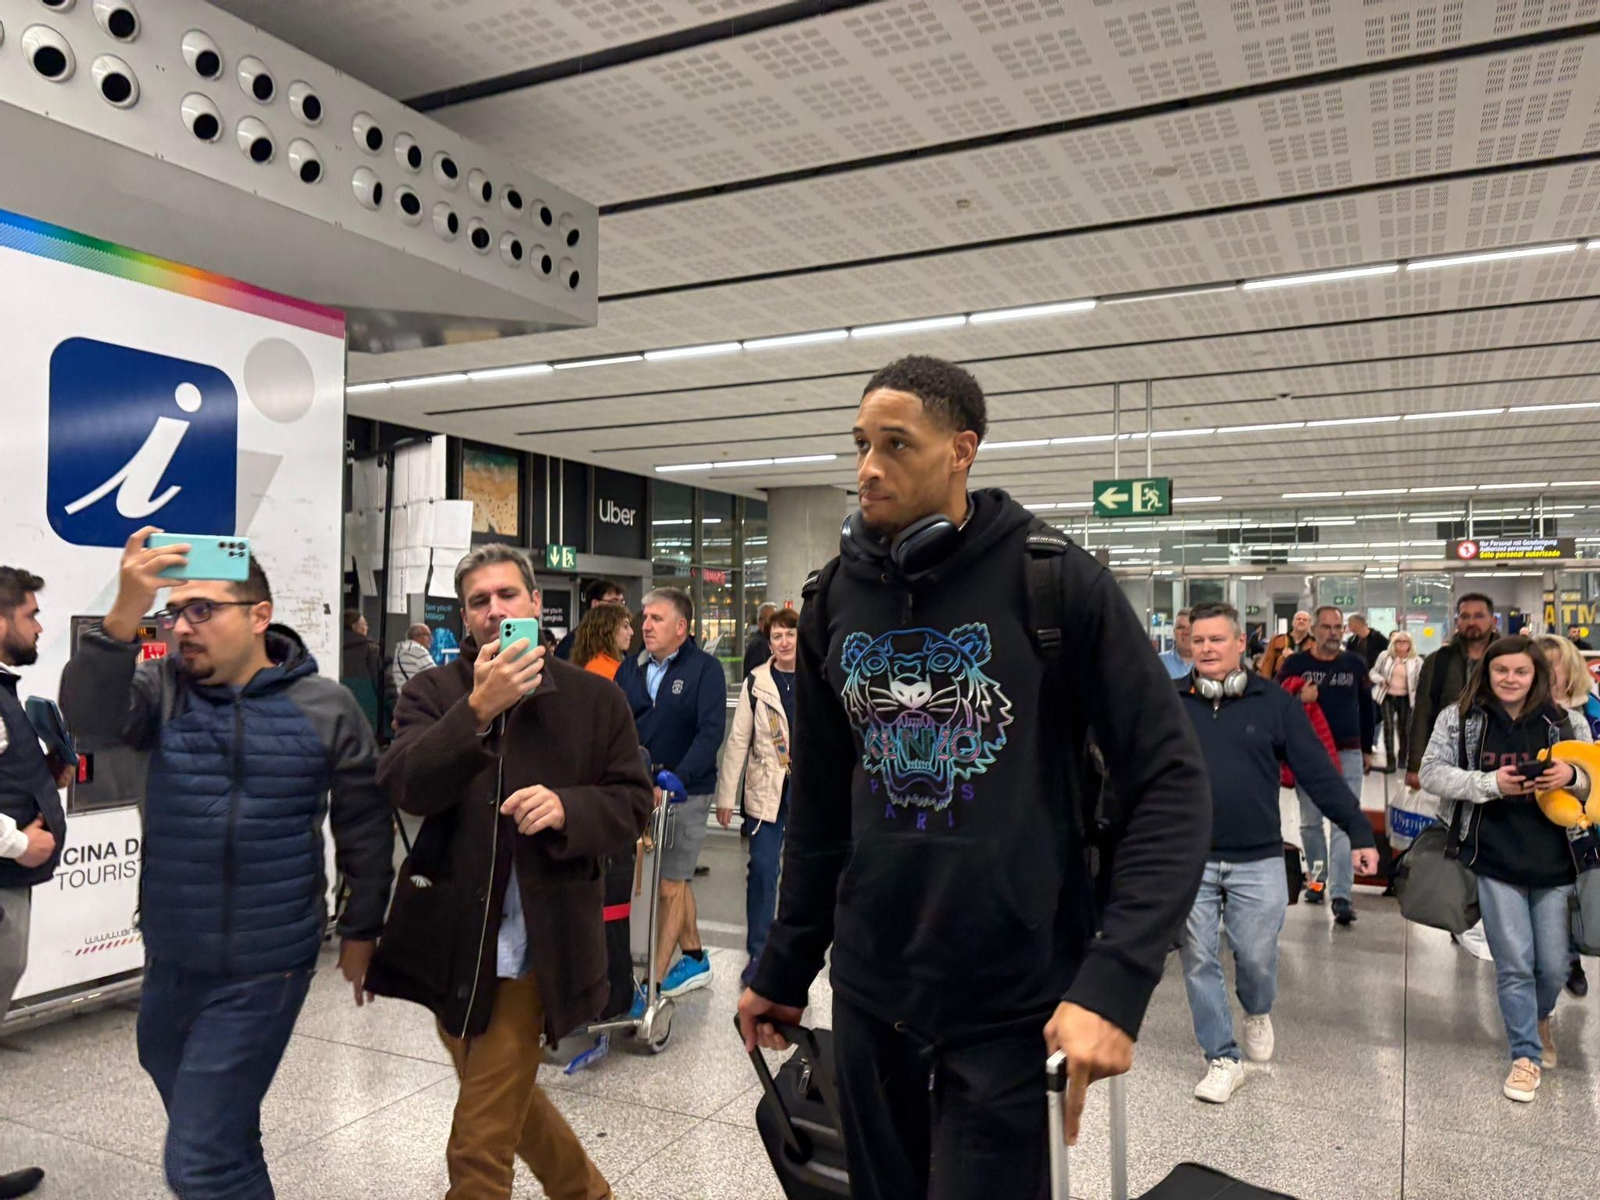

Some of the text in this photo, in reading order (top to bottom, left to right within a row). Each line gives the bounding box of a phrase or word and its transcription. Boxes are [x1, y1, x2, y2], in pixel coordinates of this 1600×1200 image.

[599, 498, 636, 526] Uber
[1495, 550, 1523, 559] personal
[1525, 549, 1560, 558] autorizado
[1544, 602, 1597, 625] ATM
[864, 727, 981, 762] KENZO
[870, 779, 976, 830] PARIS
[63, 838, 140, 865] CINA D
